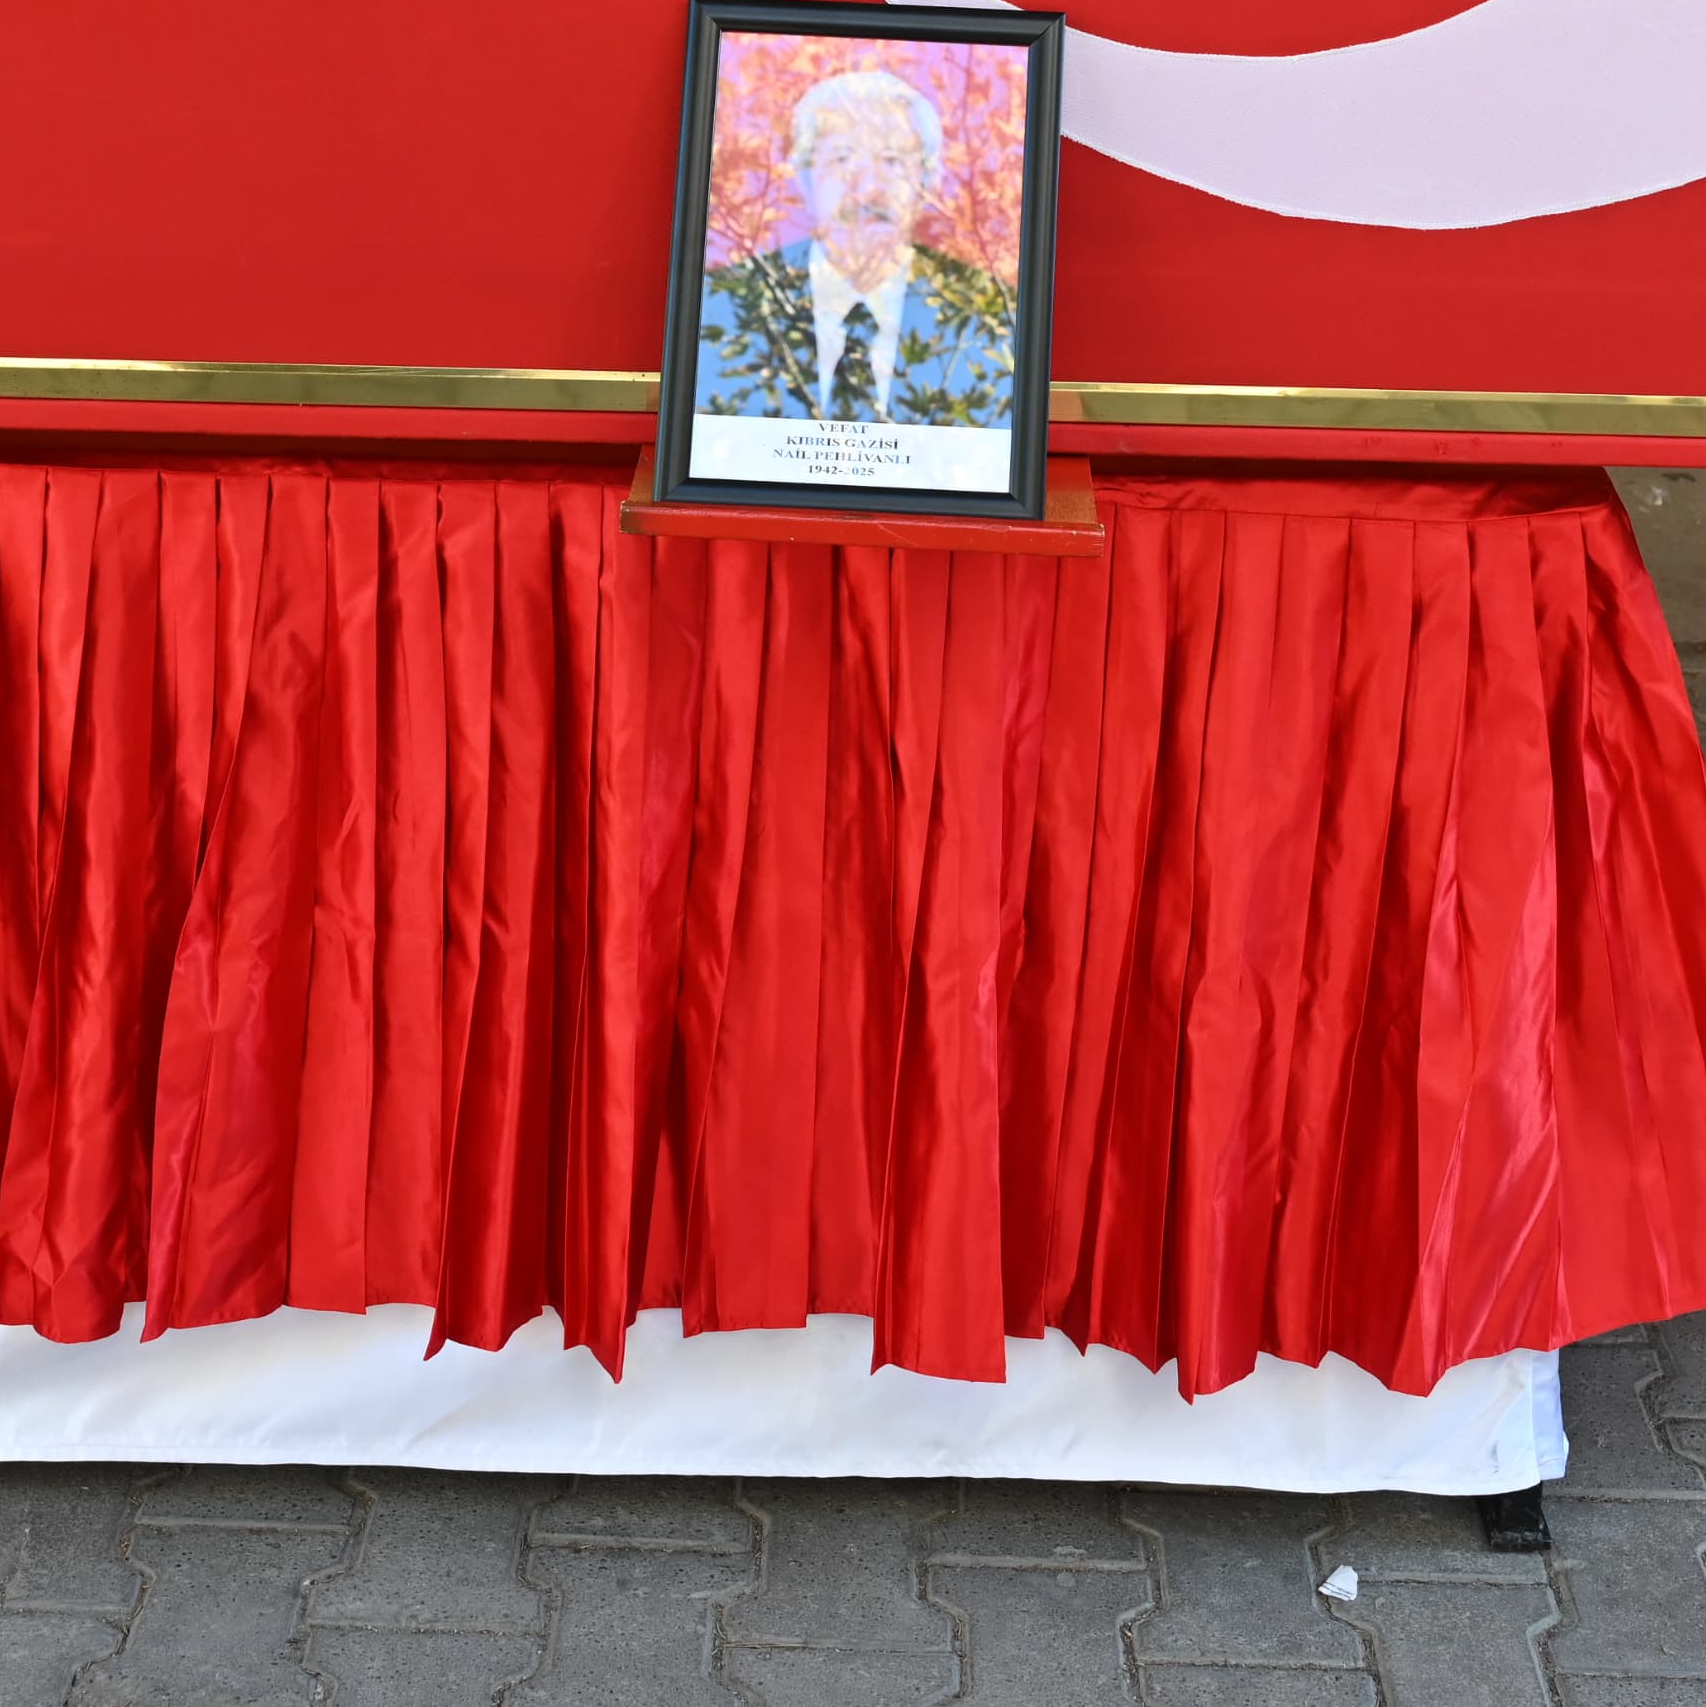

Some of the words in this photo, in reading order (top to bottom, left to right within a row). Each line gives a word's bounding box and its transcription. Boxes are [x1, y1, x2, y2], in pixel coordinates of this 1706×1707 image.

[818, 423, 869, 434] VEFAT
[786, 435, 841, 447] KIBRIS
[844, 437, 899, 450] GAZİSİ
[773, 448, 811, 460] NAİL
[814, 450, 913, 465] PEHLİVANLI
